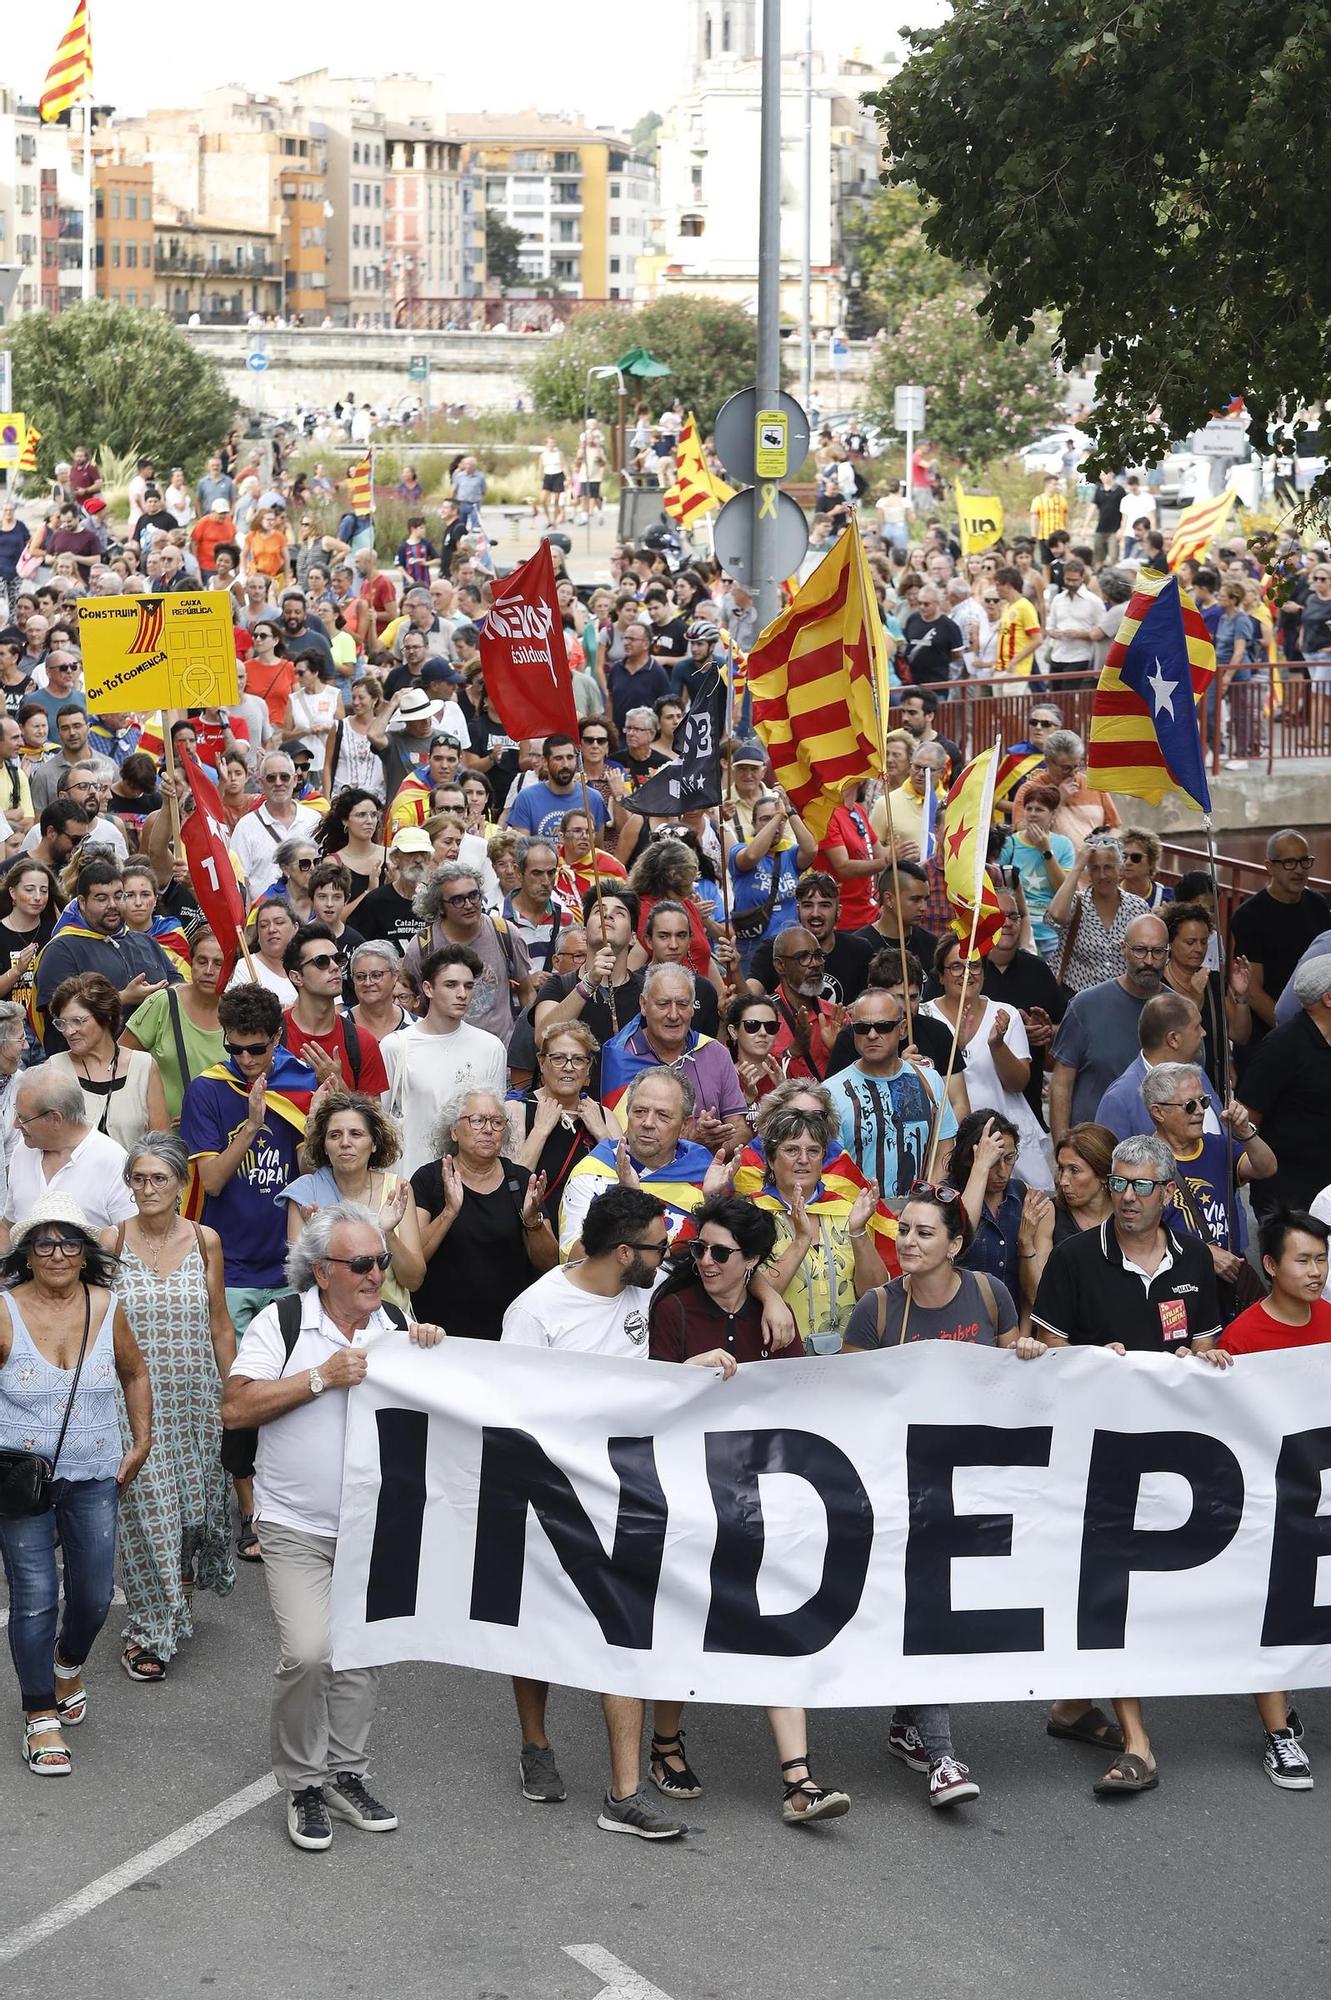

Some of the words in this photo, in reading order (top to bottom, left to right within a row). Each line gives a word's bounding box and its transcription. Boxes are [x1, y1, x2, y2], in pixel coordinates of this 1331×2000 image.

[78, 607, 138, 619] CONSTRUIM
[172, 606, 213, 616] REPÚBLICA
[257, 1146, 280, 1168] VIA
[248, 1163, 289, 1187] FORA!
[1203, 1200, 1226, 1222] VIA
